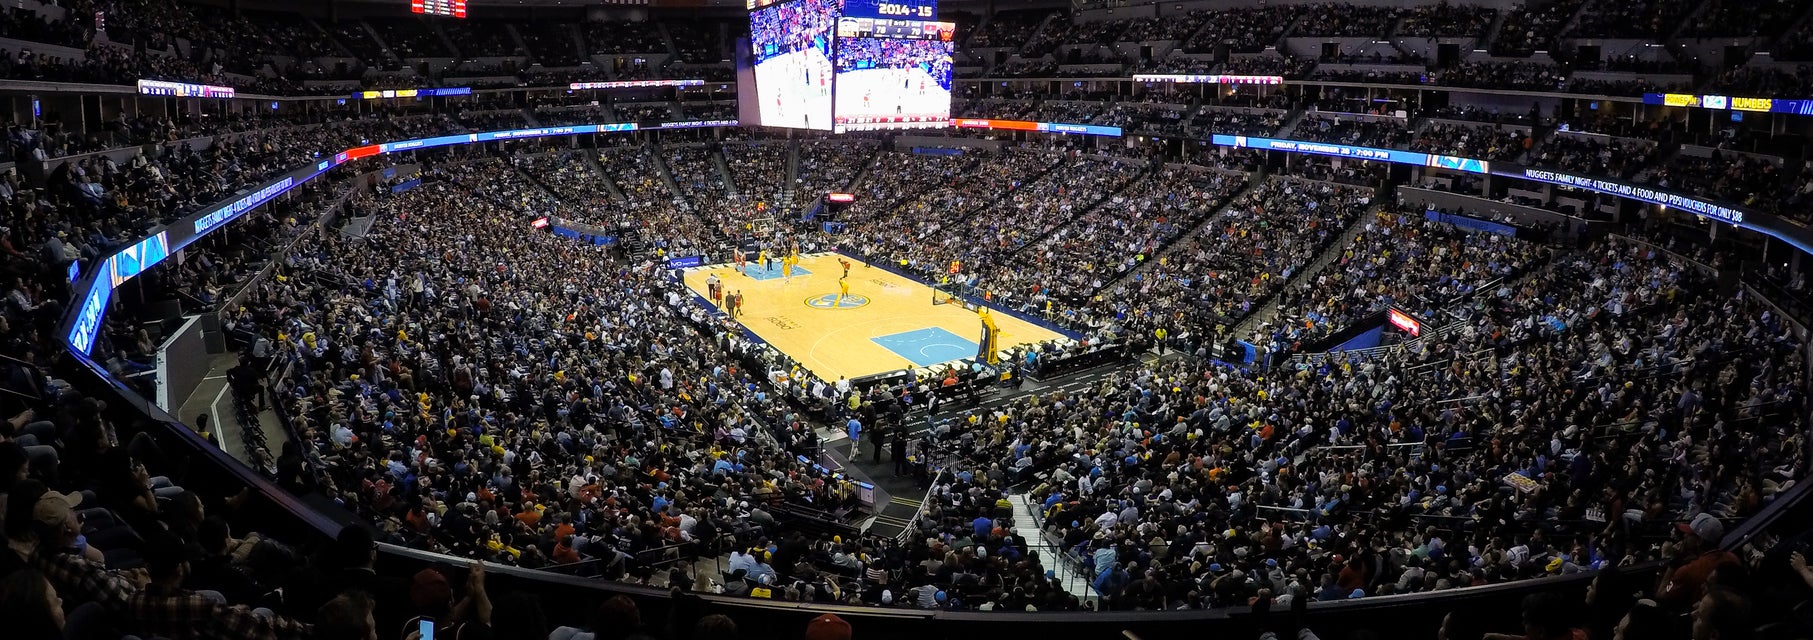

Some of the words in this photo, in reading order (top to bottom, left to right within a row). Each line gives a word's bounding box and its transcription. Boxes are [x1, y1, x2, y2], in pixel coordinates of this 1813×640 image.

[1731, 97, 1772, 109] NUMBERS
[1270, 141, 1297, 150] FRIDAY,
[1299, 143, 1340, 154] NOVEMBER
[1341, 147, 1350, 155] 28
[1356, 149, 1373, 157] 7:00
[1375, 150, 1389, 159] PM
[1525, 168, 1554, 181] NUGGETS
[1555, 173, 1574, 184] FAMILY
[1597, 180, 1618, 192] TICKETS
[1618, 184, 1631, 195] AND
[1631, 187, 1636, 196] 4
[1637, 188, 1654, 199] FOOD
[1654, 191, 1668, 203] AND
[1669, 194, 1682, 206] PEPSI
[1682, 197, 1707, 213] VOUCHERS
[1707, 204, 1717, 216] FOR
[1717, 206, 1732, 220] ONLY
[1732, 209, 1743, 222] $88
